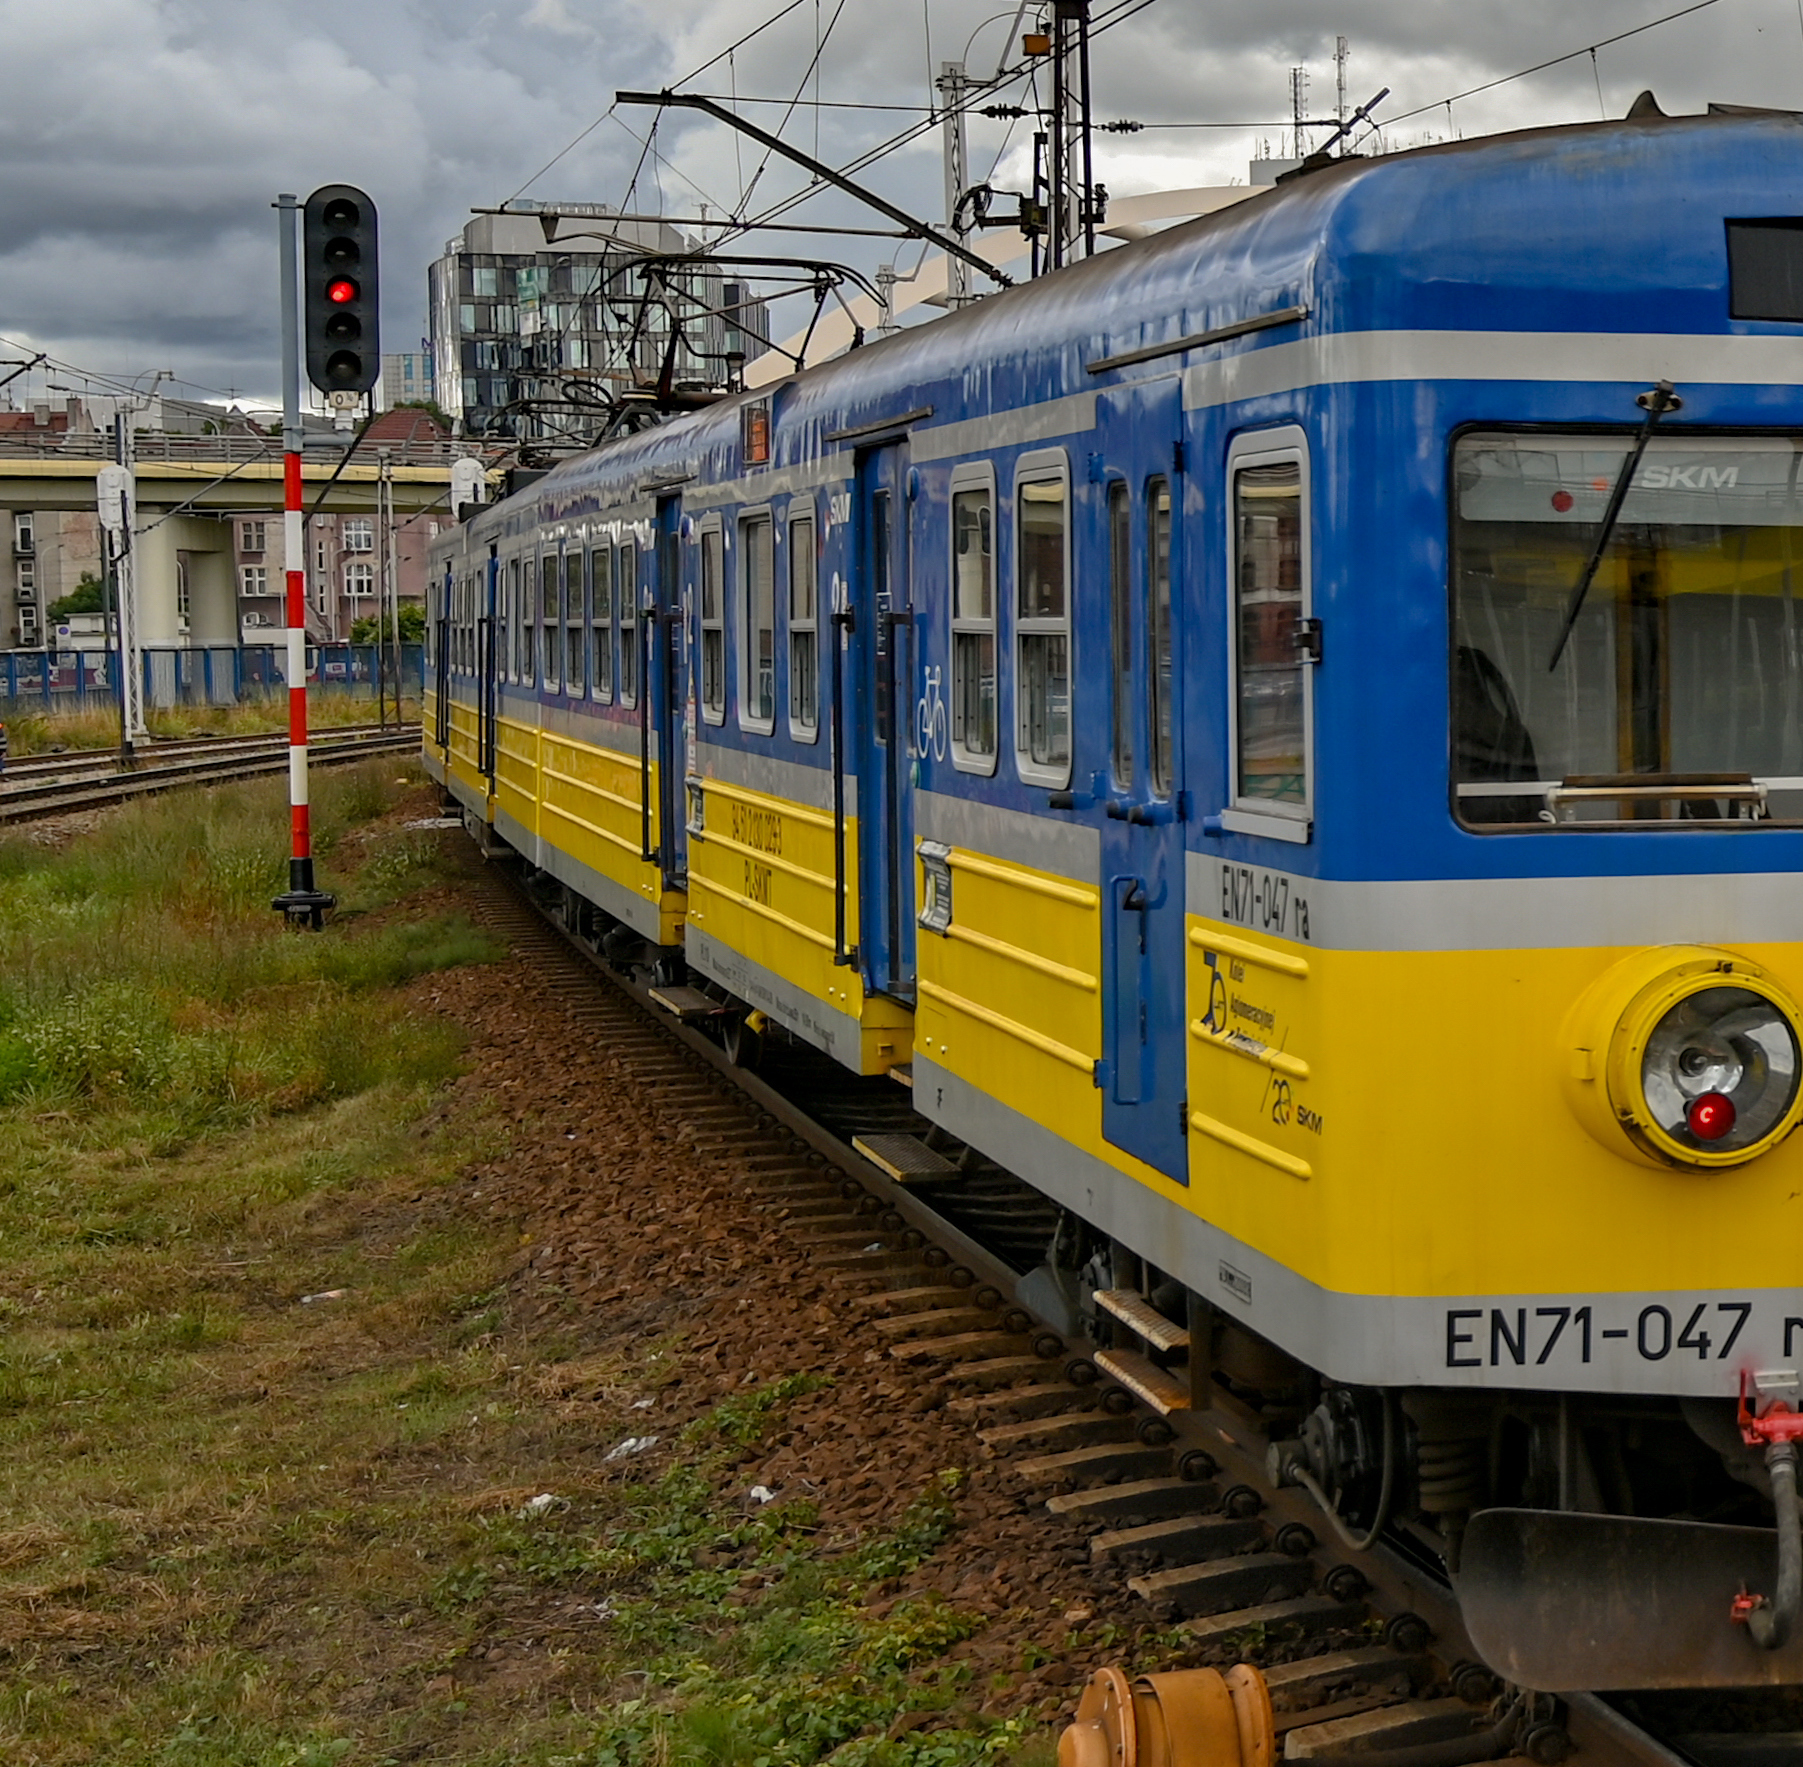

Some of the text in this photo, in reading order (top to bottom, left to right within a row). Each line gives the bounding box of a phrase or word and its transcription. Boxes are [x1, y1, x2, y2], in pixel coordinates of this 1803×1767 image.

[1641, 465, 1738, 489] SKM
[1223, 864, 1310, 940] EN71-047 ra
[1297, 1104, 1325, 1136] SKM
[1445, 1301, 1751, 1369] EN71-047
